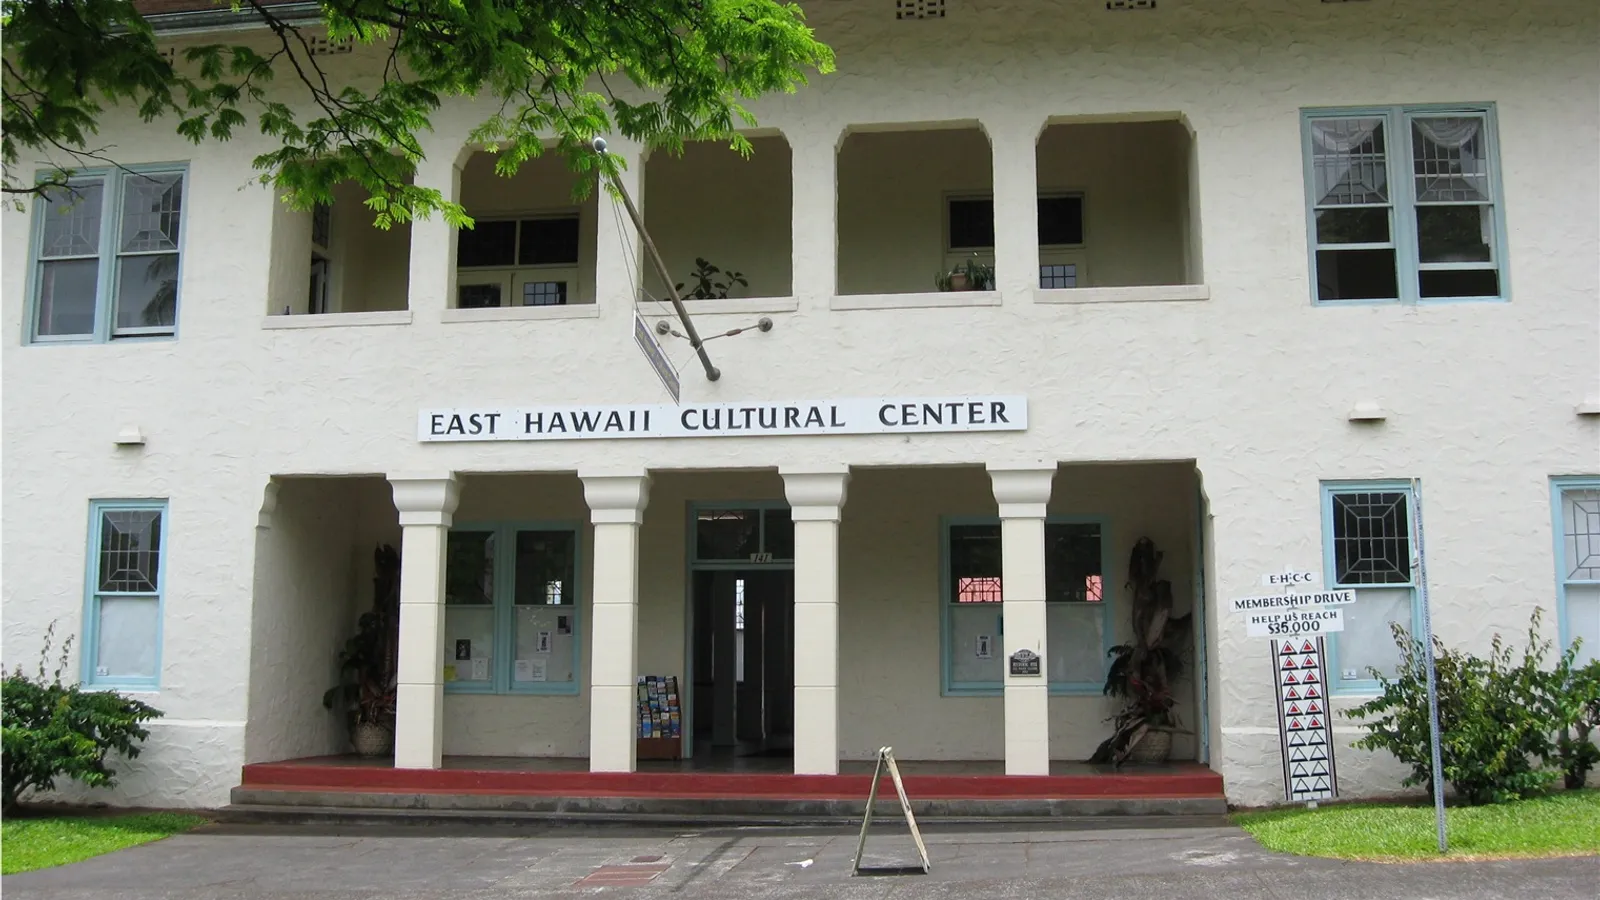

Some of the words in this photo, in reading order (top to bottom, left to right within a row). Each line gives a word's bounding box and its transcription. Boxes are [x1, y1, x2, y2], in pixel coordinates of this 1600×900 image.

[430, 413, 500, 435] EAST
[524, 410, 650, 433] HAWAII
[680, 405, 846, 430] CULTURAL
[879, 401, 1010, 426] CENTER
[1235, 595, 1311, 609] MEMBERSHIP
[1314, 592, 1350, 603] DRIVE
[1252, 614, 1281, 624] HELP
[1301, 611, 1337, 620] REACH
